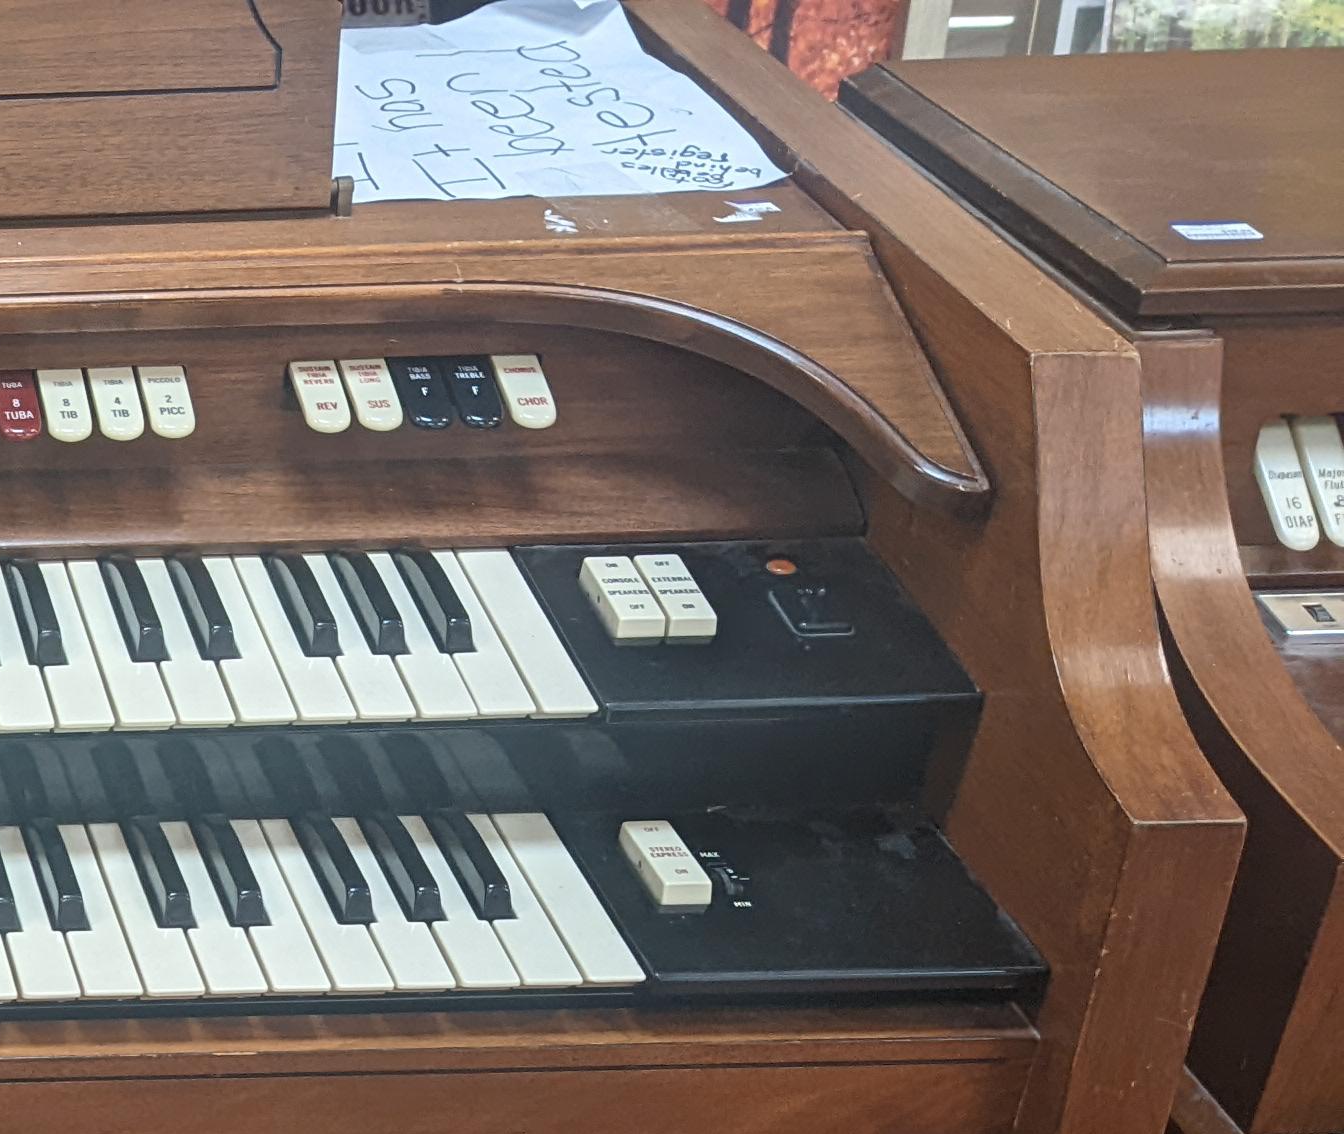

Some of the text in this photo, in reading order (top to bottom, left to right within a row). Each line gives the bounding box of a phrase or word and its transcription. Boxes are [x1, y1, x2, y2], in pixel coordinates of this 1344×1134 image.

[416, 41, 676, 146] tested
[446, 72, 574, 157] been
[600, 145, 729, 162] register
[421, 386, 429, 396] F
[472, 385, 479, 396] F
[12, 398, 20, 407] 8
[62, 398, 70, 407] 8
[114, 397, 122, 405] 4
[164, 395, 173, 403] 2
[517, 397, 548, 406] CHOR
[316, 402, 337, 410] REV
[367, 400, 391, 408] SUS
[59, 410, 78, 419] TIB
[111, 409, 130, 418] TIB
[159, 406, 185, 415] PICC
[4, 411, 34, 420] TUBA
[1285, 497, 1302, 509] 16
[1285, 516, 1313, 529] DIAP
